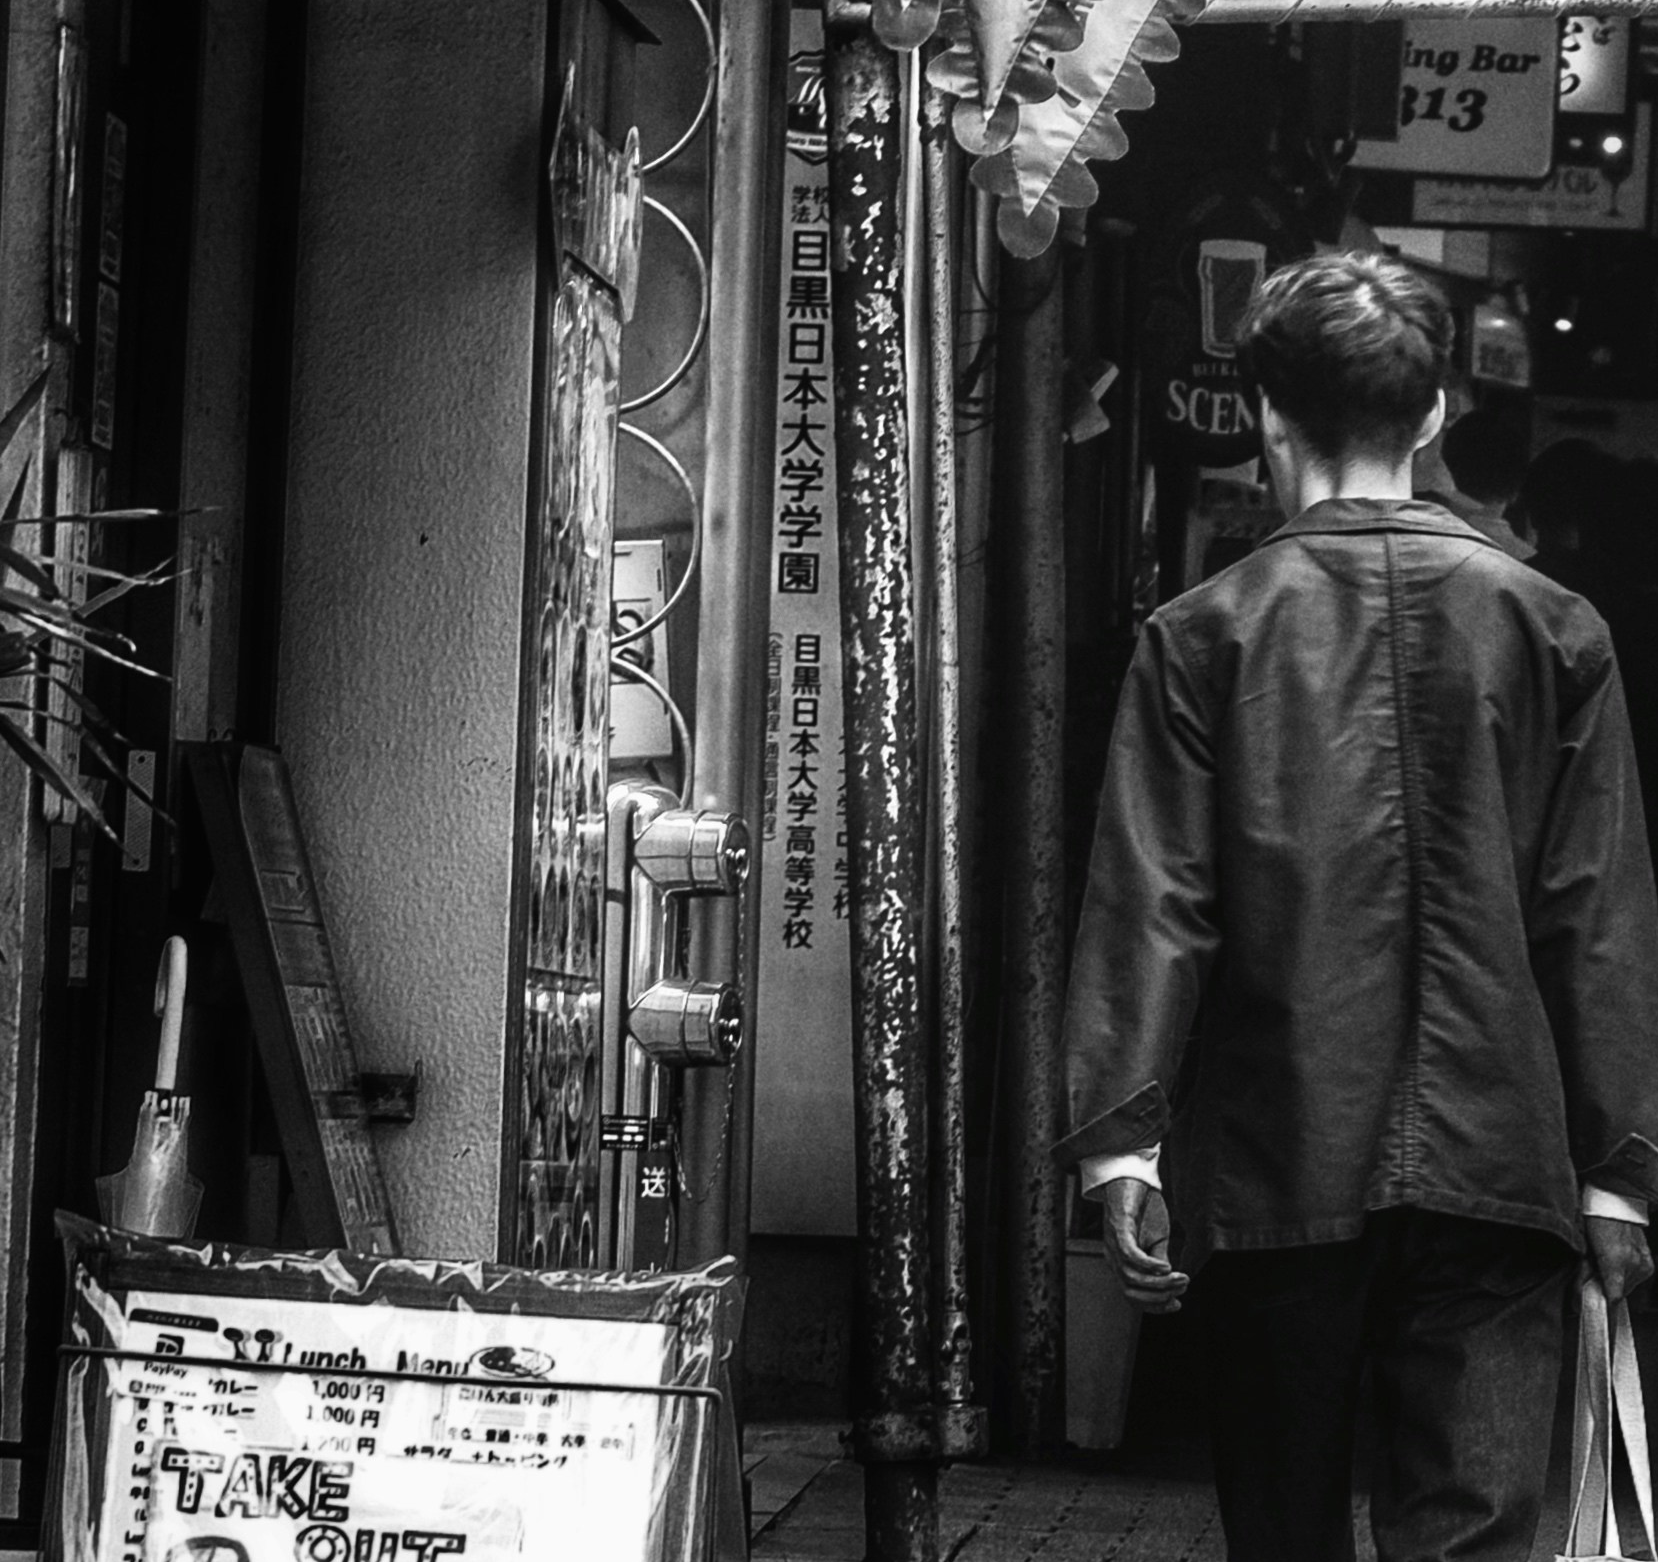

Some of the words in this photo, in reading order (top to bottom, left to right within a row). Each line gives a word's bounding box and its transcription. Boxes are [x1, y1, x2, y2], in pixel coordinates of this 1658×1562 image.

[1469, 43, 1541, 74] Bar
[778, 230, 831, 595] 目黒日本大学学園
[783, 634, 822, 949] 目黒日本大学高等学校
[360, 1409, 380, 1428] 円
[356, 1437, 376, 1456] 円
[161, 1446, 355, 1522] TAKE
